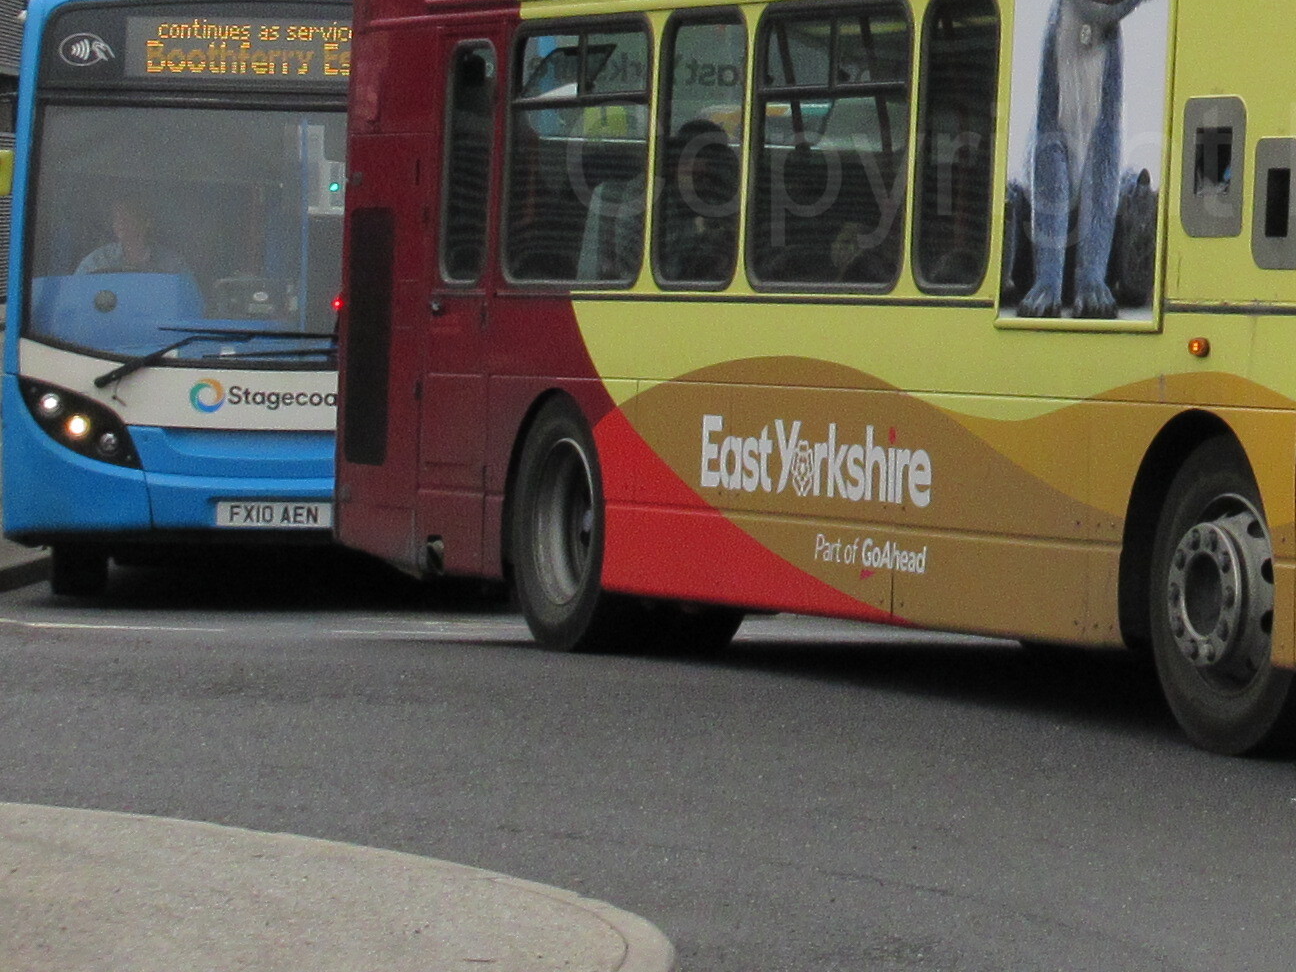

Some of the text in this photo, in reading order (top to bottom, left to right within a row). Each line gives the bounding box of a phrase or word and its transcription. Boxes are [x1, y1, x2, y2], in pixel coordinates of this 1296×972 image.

[158, 19, 353, 41] continues as servic
[146, 40, 315, 75] Boothferry
[229, 504, 319, 524] FX10 AEN
[814, 533, 928, 575] Part of GoAhead
